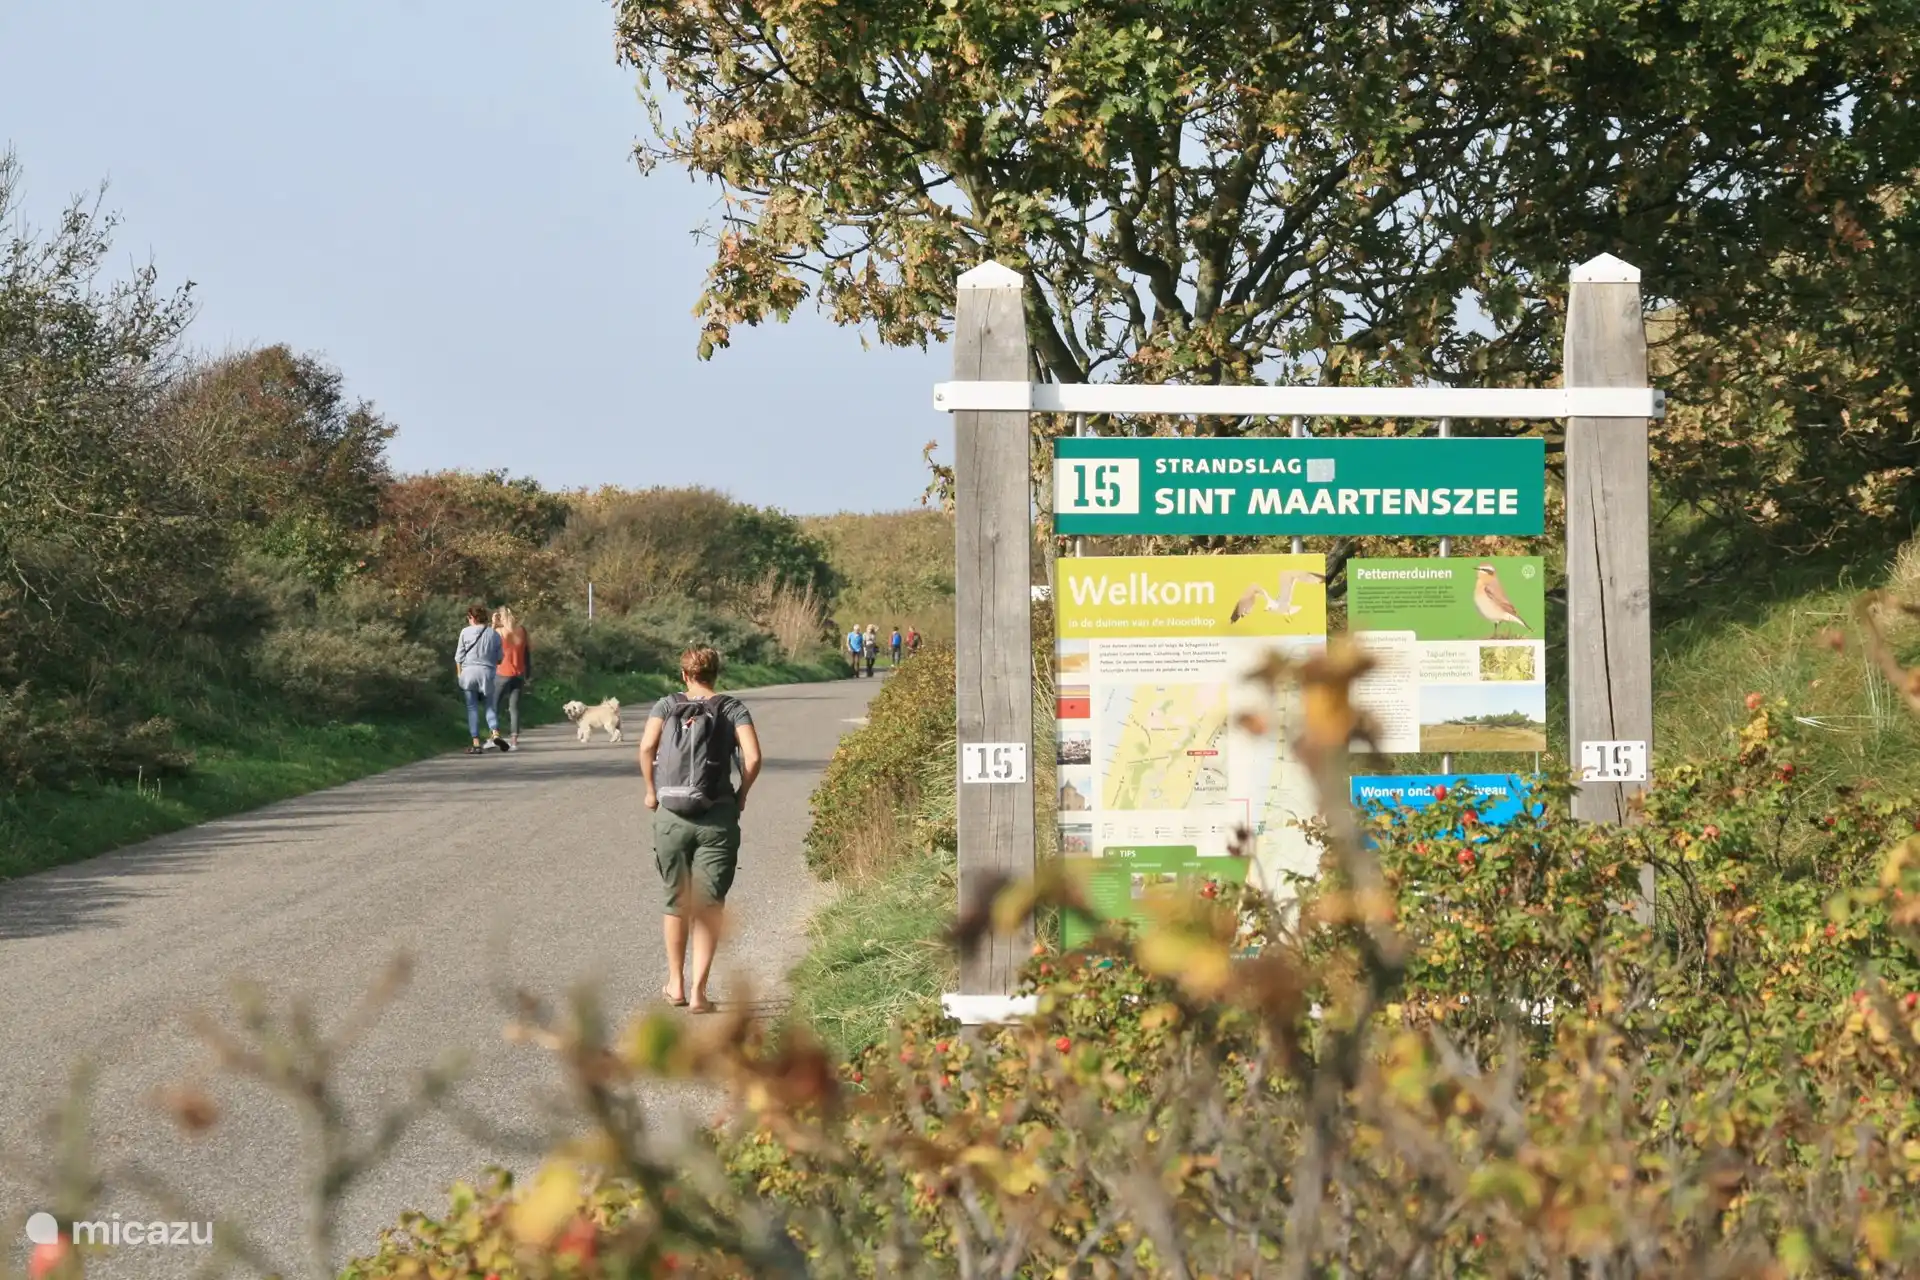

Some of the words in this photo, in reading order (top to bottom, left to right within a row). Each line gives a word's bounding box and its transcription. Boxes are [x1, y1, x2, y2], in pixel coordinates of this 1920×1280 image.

[1155, 457, 1301, 474] STRANDSLAG
[1073, 464, 1121, 507] 15
[1155, 488, 1235, 515] SINT
[1248, 488, 1518, 515] MAARTENSZEE
[1357, 567, 1453, 580] Pettemerduinen
[1068, 571, 1215, 606] Welkom
[1080, 616, 1093, 628] de
[1095, 617, 1129, 628] duinen
[1132, 618, 1150, 628] van
[1152, 616, 1165, 627] de
[1167, 616, 1216, 629] Noordkop
[977, 747, 1013, 779] 15
[1596, 745, 1632, 777] 15
[1360, 786, 1404, 798] Wonen
[1408, 785, 1445, 797] ond
[1119, 849, 1137, 858] TIPS
